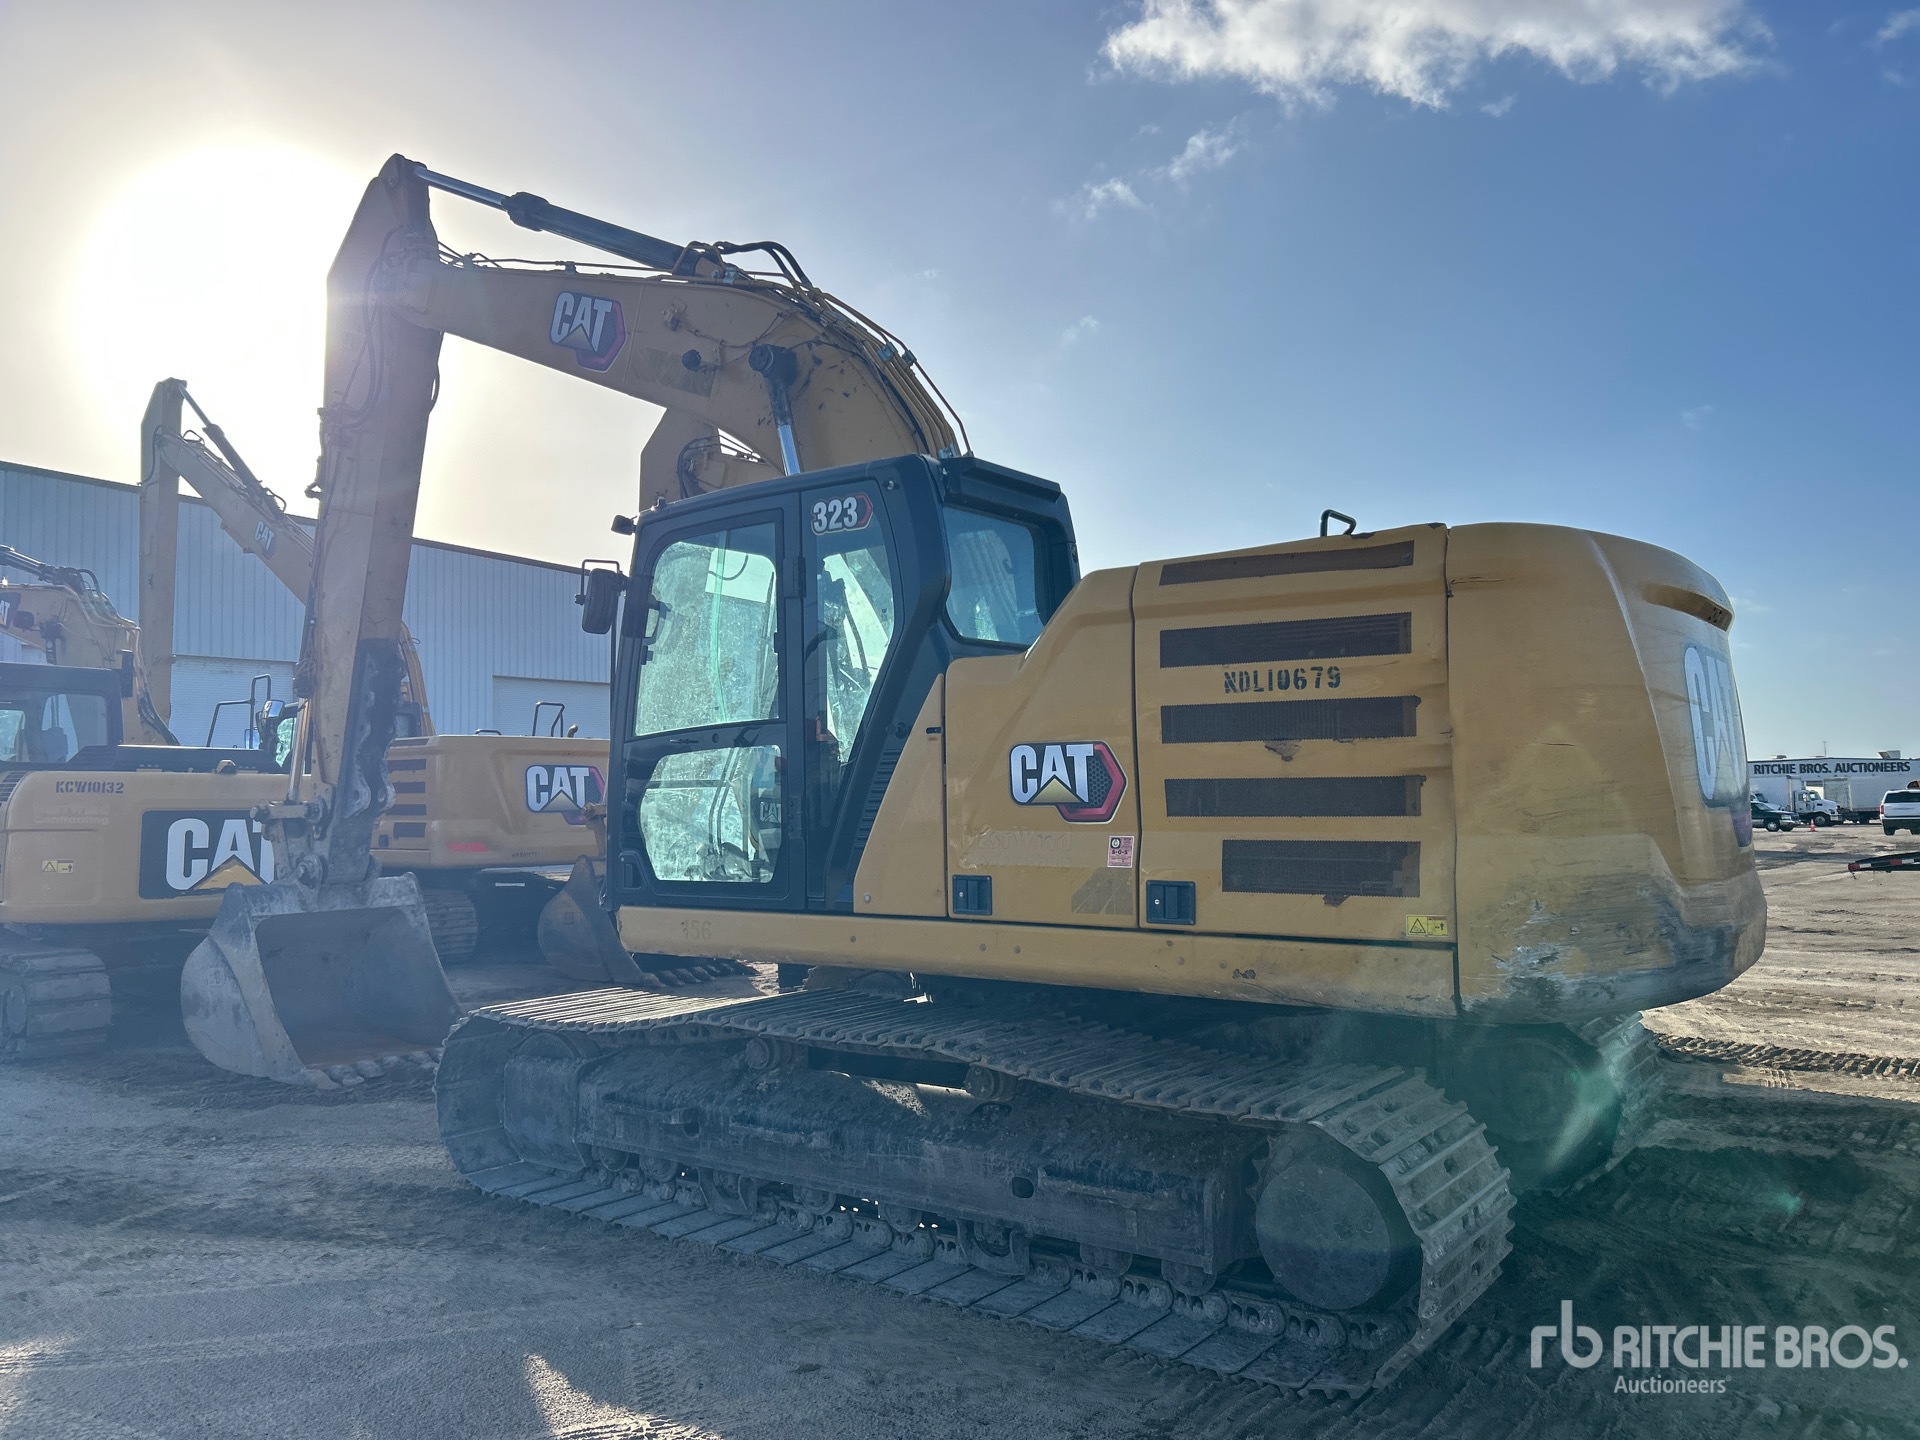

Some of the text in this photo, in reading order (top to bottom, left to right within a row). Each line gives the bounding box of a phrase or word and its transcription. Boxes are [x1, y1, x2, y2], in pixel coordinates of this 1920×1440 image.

[551, 292, 612, 352] CAT
[813, 497, 858, 532] 323
[255, 521, 275, 551] CAT
[1684, 647, 1744, 800] CAT
[55, 780, 125, 794] KCW10132
[527, 765, 590, 812] CAT
[1010, 743, 1094, 803] CAT
[1753, 761, 1911, 775] RITCHIE BROS. AUCTIONEERS
